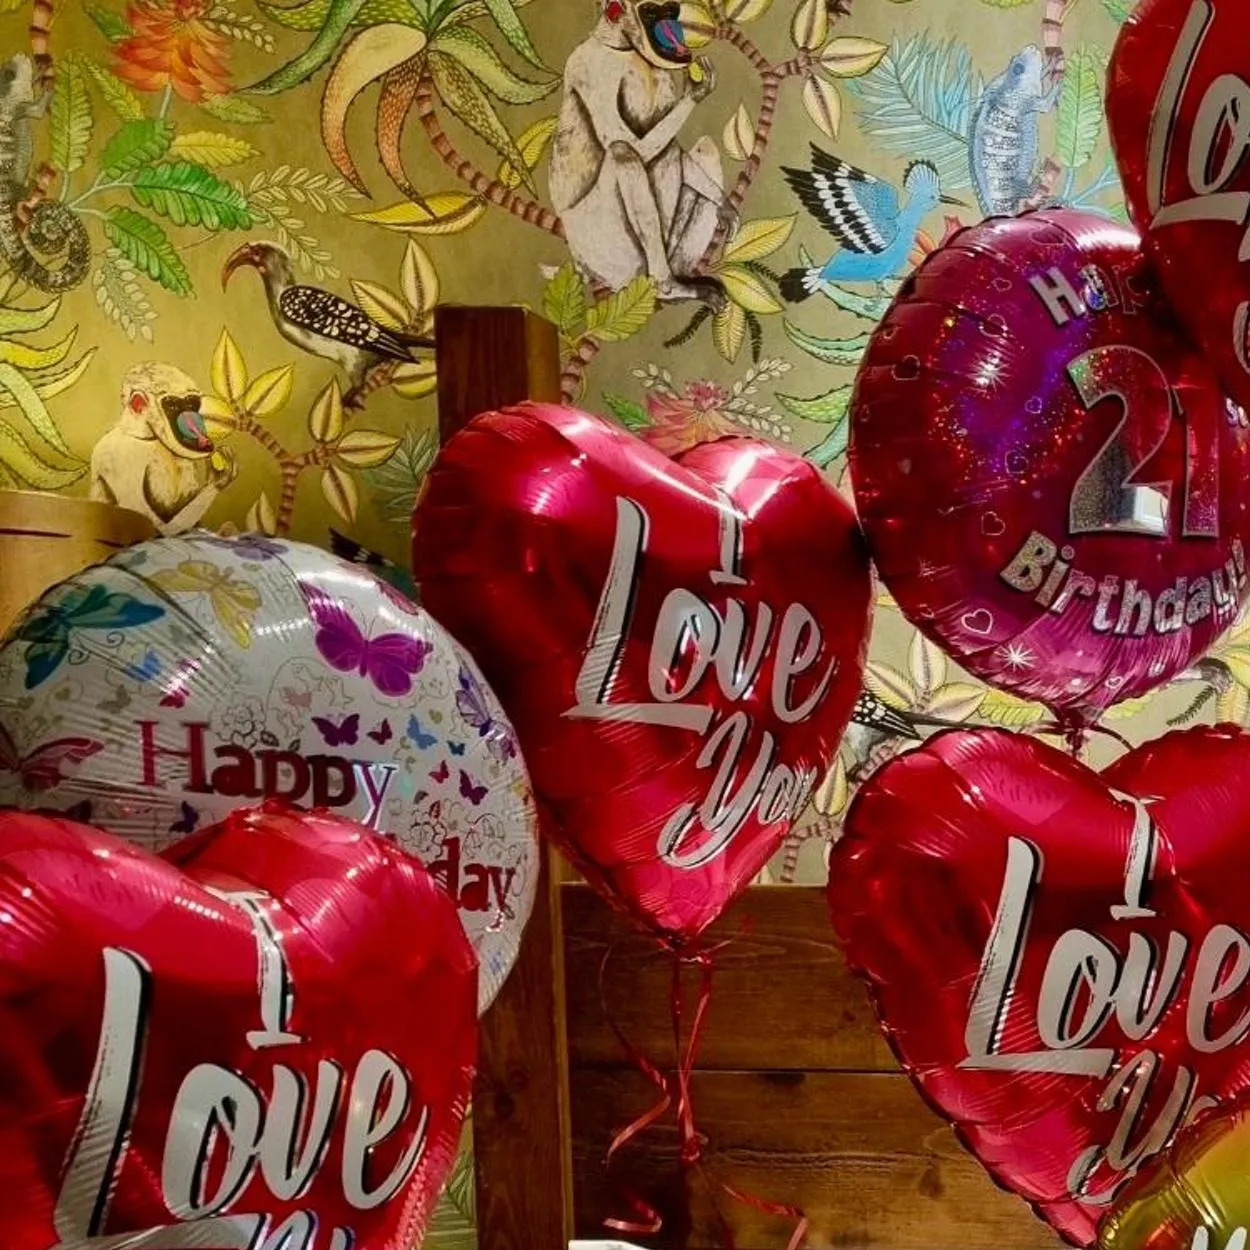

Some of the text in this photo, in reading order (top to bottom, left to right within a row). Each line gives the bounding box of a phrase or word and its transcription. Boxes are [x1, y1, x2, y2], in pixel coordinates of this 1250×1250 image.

[709, 482, 750, 585] I
[1000, 530, 1247, 637] Birthday!
[560, 496, 838, 735] Love
[1109, 788, 1166, 921] I
[203, 884, 309, 1050] I
